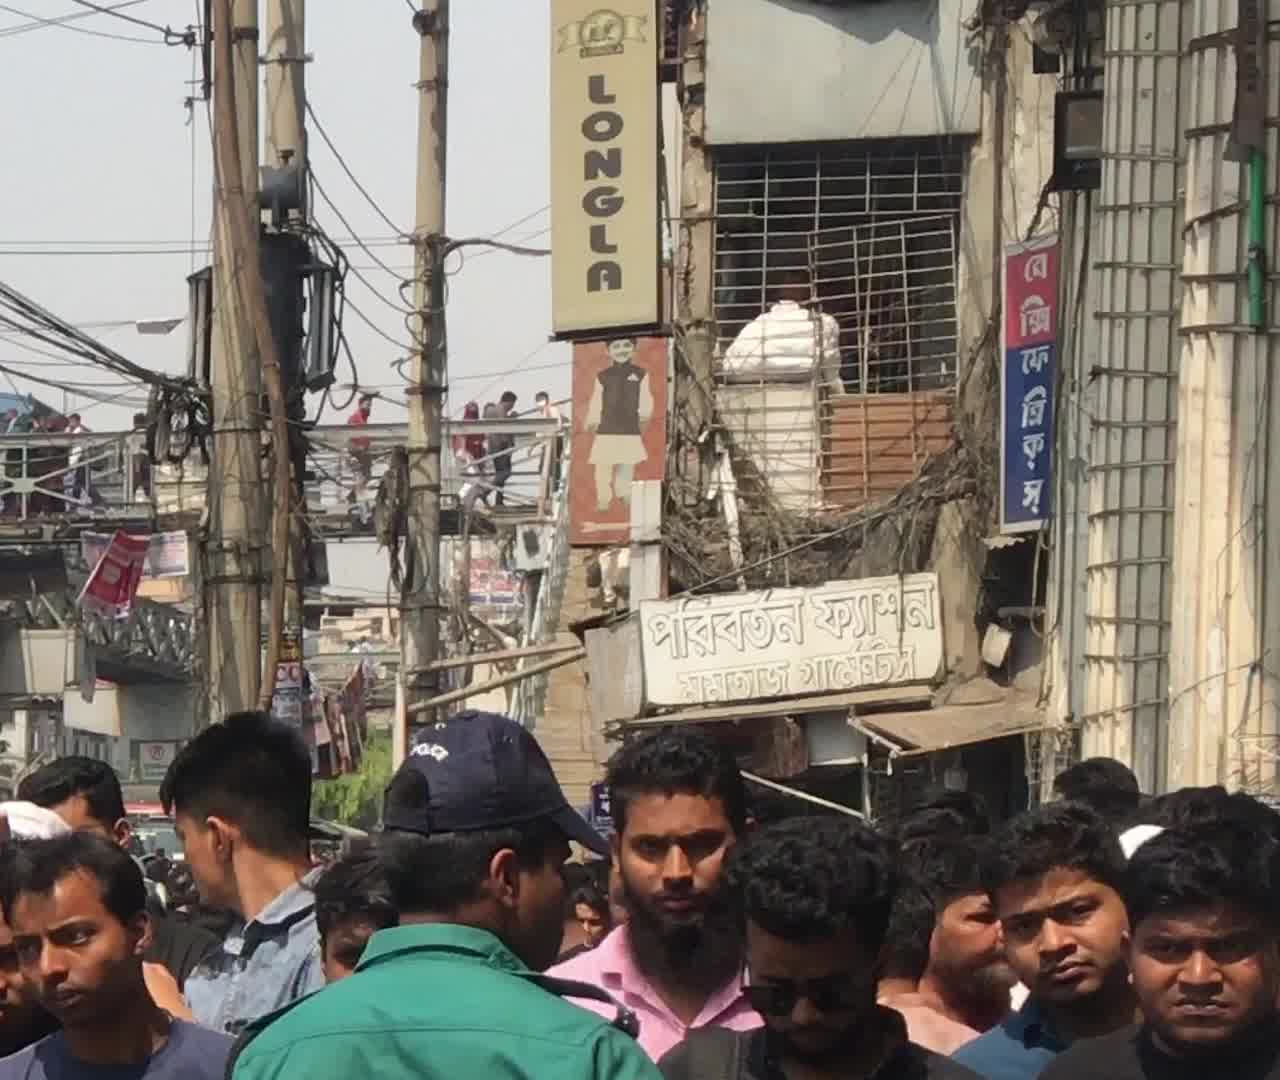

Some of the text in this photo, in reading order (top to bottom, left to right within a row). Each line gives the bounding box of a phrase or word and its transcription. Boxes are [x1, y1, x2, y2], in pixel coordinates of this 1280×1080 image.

[581, 74, 624, 293] LONGLA
[649, 581, 936, 659] পরিবর্তন ফ্যাশন
